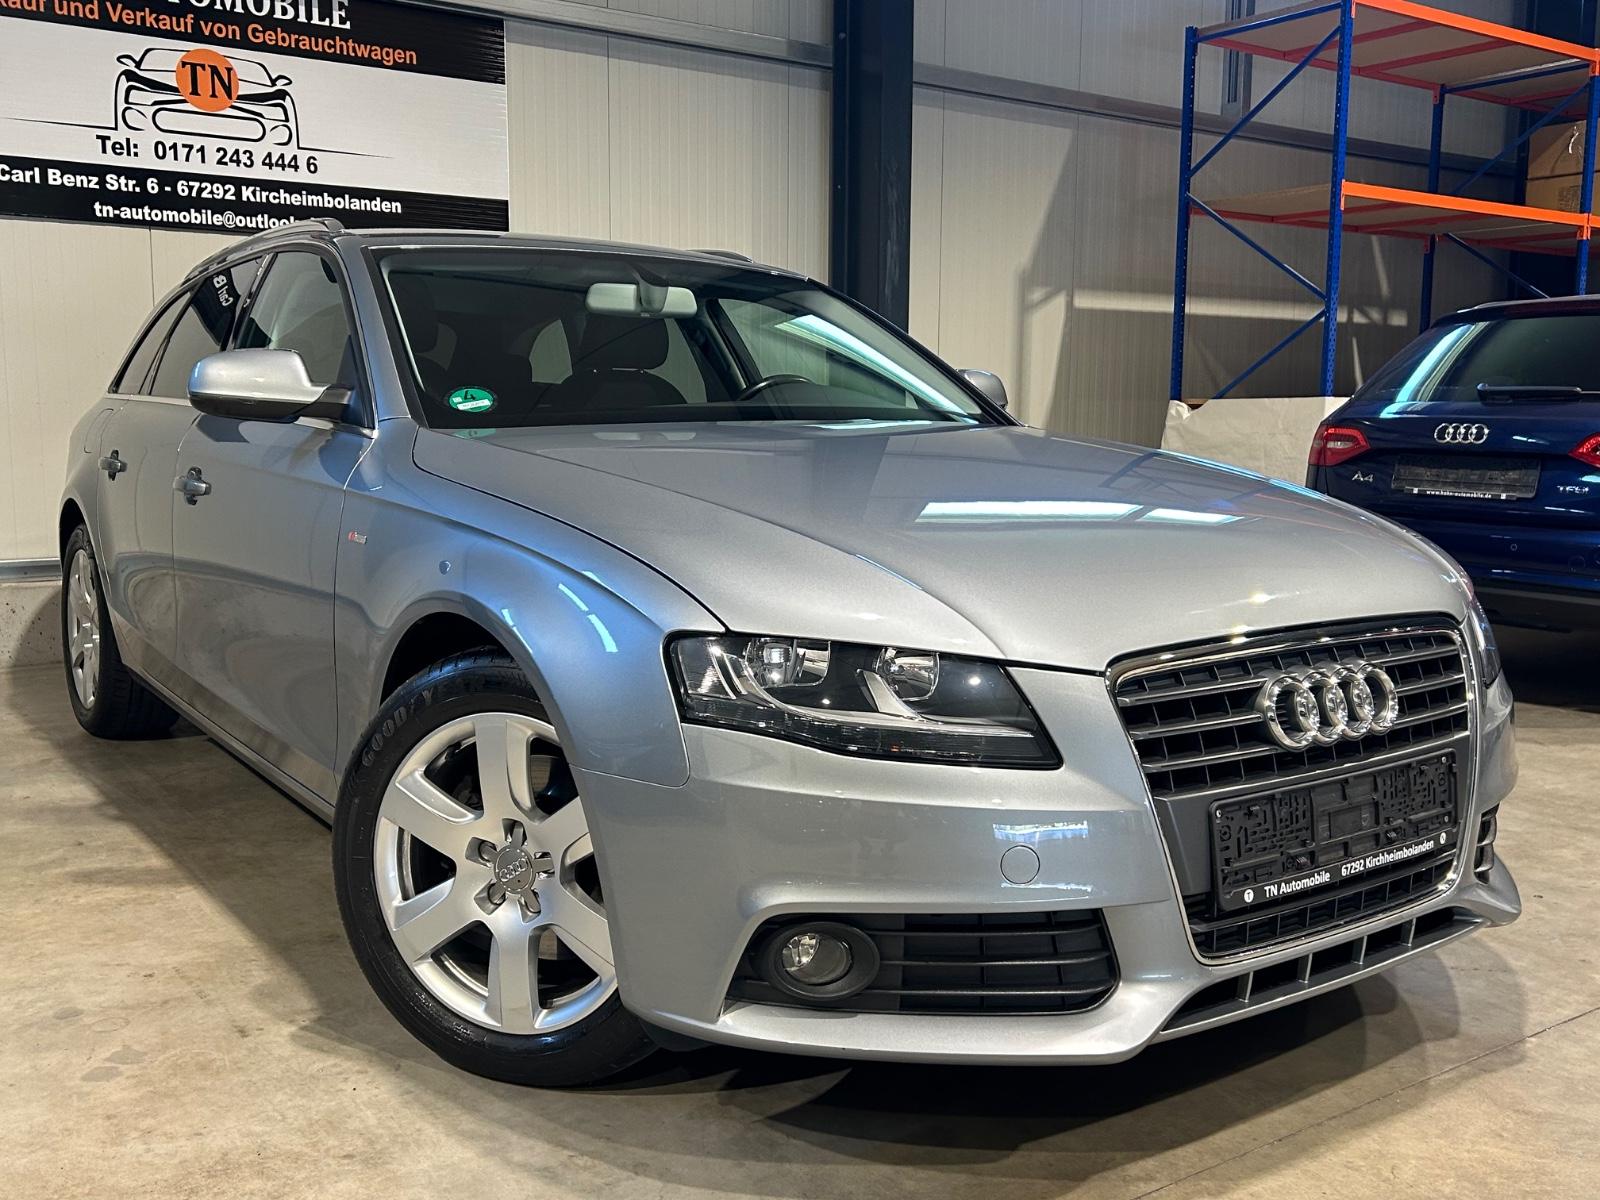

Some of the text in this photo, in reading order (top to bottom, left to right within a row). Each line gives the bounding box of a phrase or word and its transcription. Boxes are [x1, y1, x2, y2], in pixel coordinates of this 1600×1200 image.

[54, 0, 99, 20] und
[106, 2, 194, 33] Verkauf
[200, 20, 240, 40] von
[247, 23, 417, 65] Gebrauchtwagen
[168, 0, 351, 30] OBILE
[181, 61, 233, 100] TN
[96, 134, 318, 174] Tel: 0171 243 444 6
[0, 163, 40, 184] Carl
[48, 168, 100, 189] Benz
[105, 173, 141, 193] Str.
[146, 177, 159, 194] 6
[177, 180, 236, 200] 67292
[241, 185, 402, 214] Kircheimbolanden
[1351, 470, 1374, 483] A4
[1264, 884, 1278, 898] TN
[1280, 871, 1331, 895] Automobile
[1341, 860, 1365, 876] 67292
[1365, 840, 1434, 869] Kirchheimbolanden
